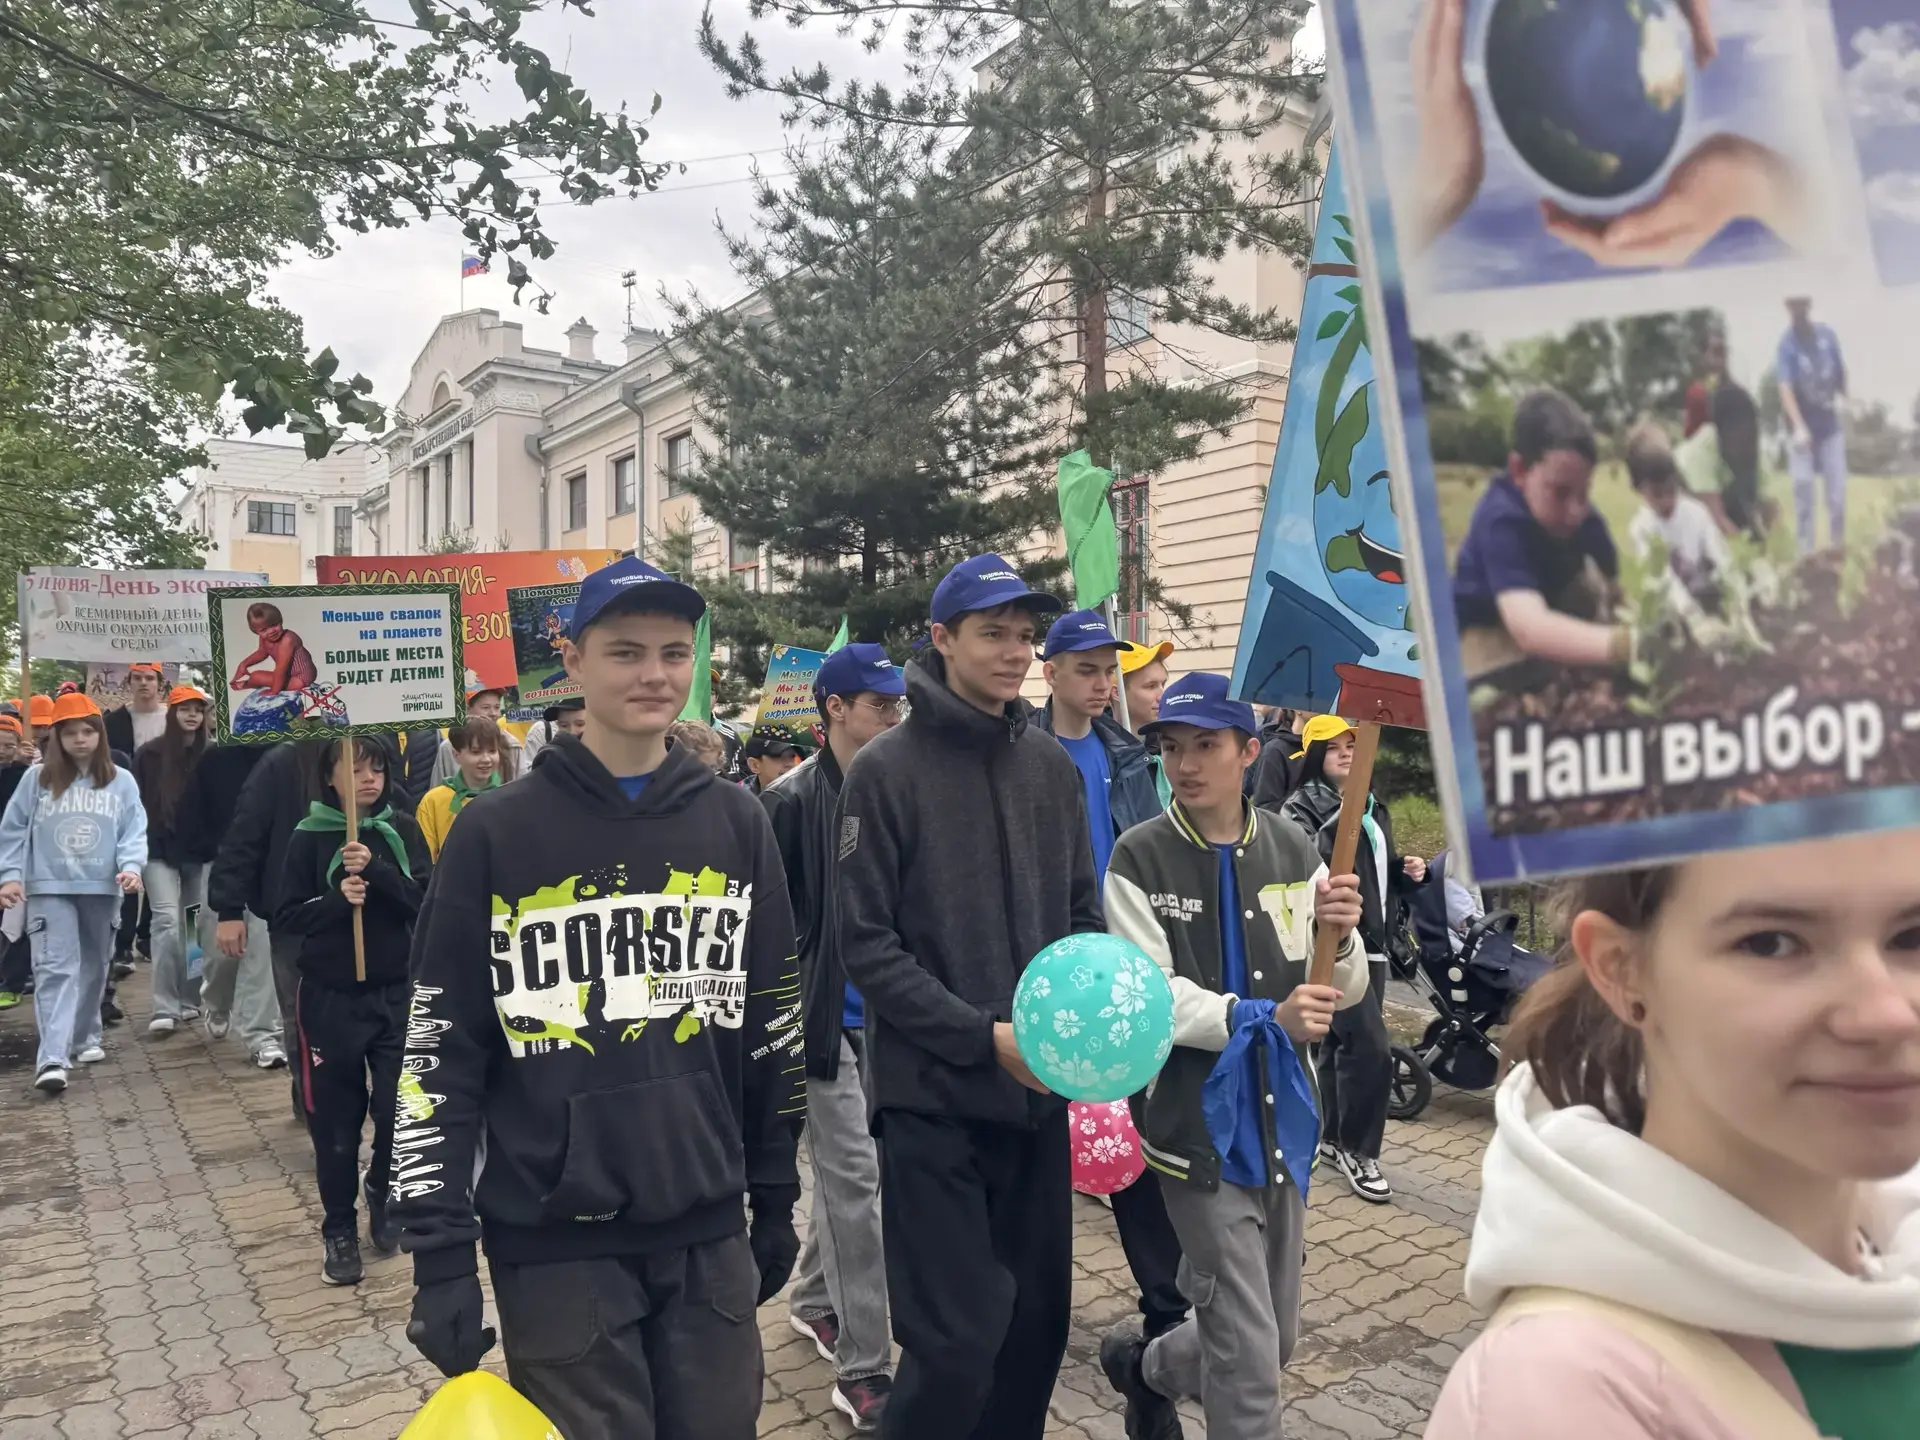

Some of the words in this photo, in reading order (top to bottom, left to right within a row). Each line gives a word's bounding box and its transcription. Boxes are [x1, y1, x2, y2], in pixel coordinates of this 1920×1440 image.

[519, 587, 570, 598] Помоги
[75, 607, 158, 620] ВСЕМИРНЫЙ
[162, 609, 202, 621] ДЕНЬ
[322, 611, 384, 622] Меньше
[390, 609, 442, 620] свалок
[56, 620, 106, 634] ОХРАНЫ
[360, 629, 377, 640] на
[383, 627, 442, 639] планете
[111, 638, 159, 650] СРЕДЫ
[325, 649, 390, 664] БОЛЬШЕ
[396, 646, 444, 661] МЕСТА
[336, 669, 383, 685] БУДЕТ
[390, 666, 445, 683] ДЕТЯМ!
[776, 684, 793, 692] Мы
[403, 701, 443, 713] ПРИРОДЫ
[772, 697, 790, 705] Мы
[1494, 722, 1645, 804] Наш
[1660, 685, 1884, 783] выбор
[1181, 898, 1202, 912] ME
[490, 905, 751, 997] SCORSES
